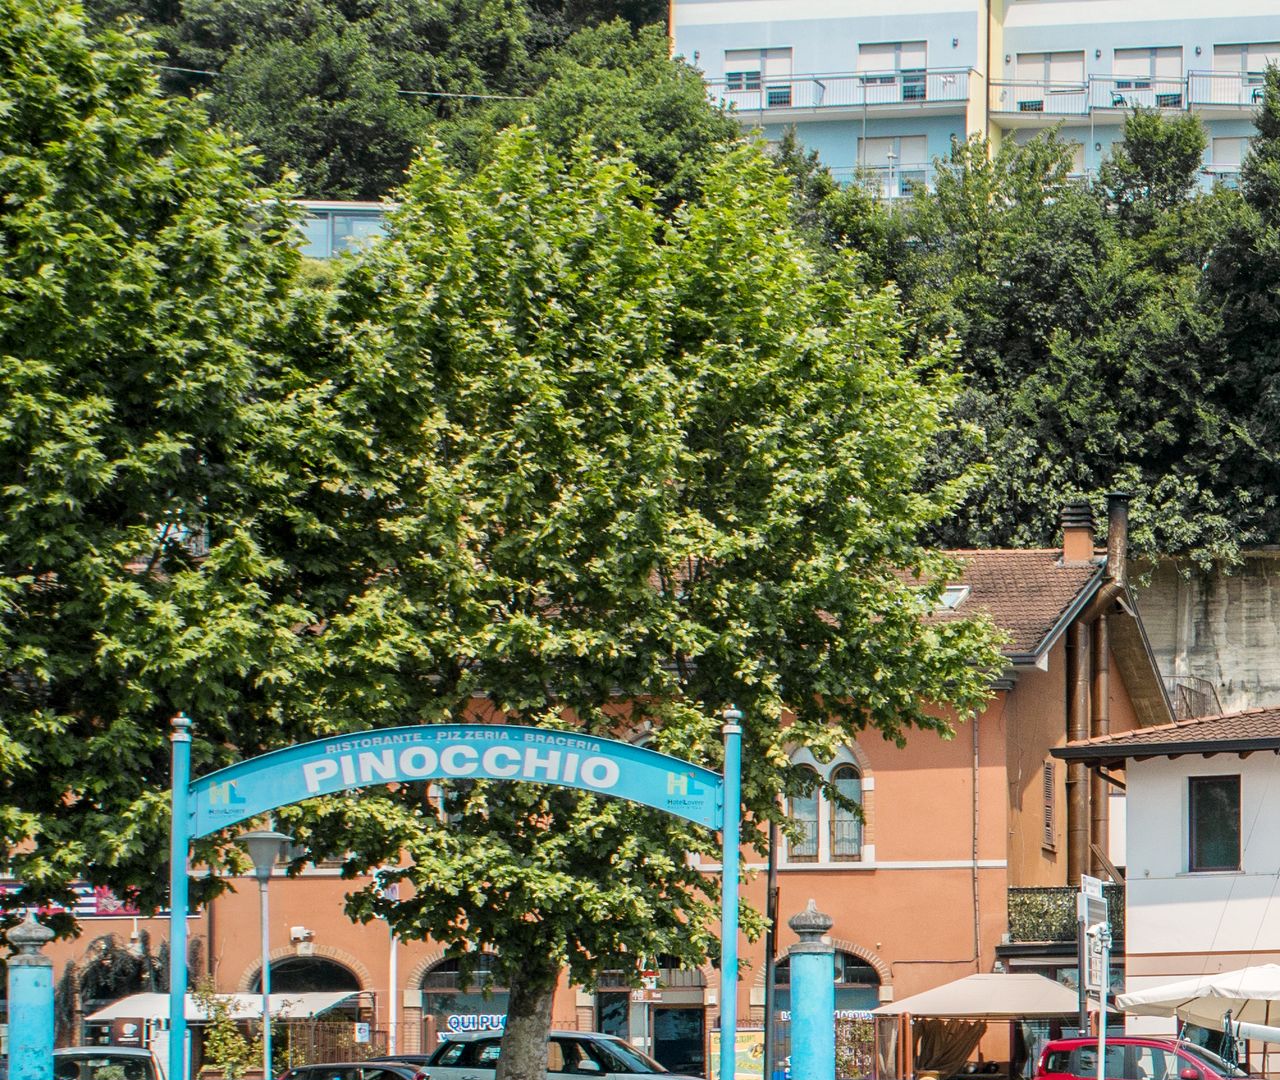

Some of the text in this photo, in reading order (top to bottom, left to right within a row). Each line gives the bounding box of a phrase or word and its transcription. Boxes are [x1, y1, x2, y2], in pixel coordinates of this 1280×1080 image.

[325, 732, 422, 754] RISTORANTE
[523, 733, 601, 752] BRACERIA
[303, 745, 620, 793] PINOCCHIO
[447, 1014, 478, 1033] QUI
